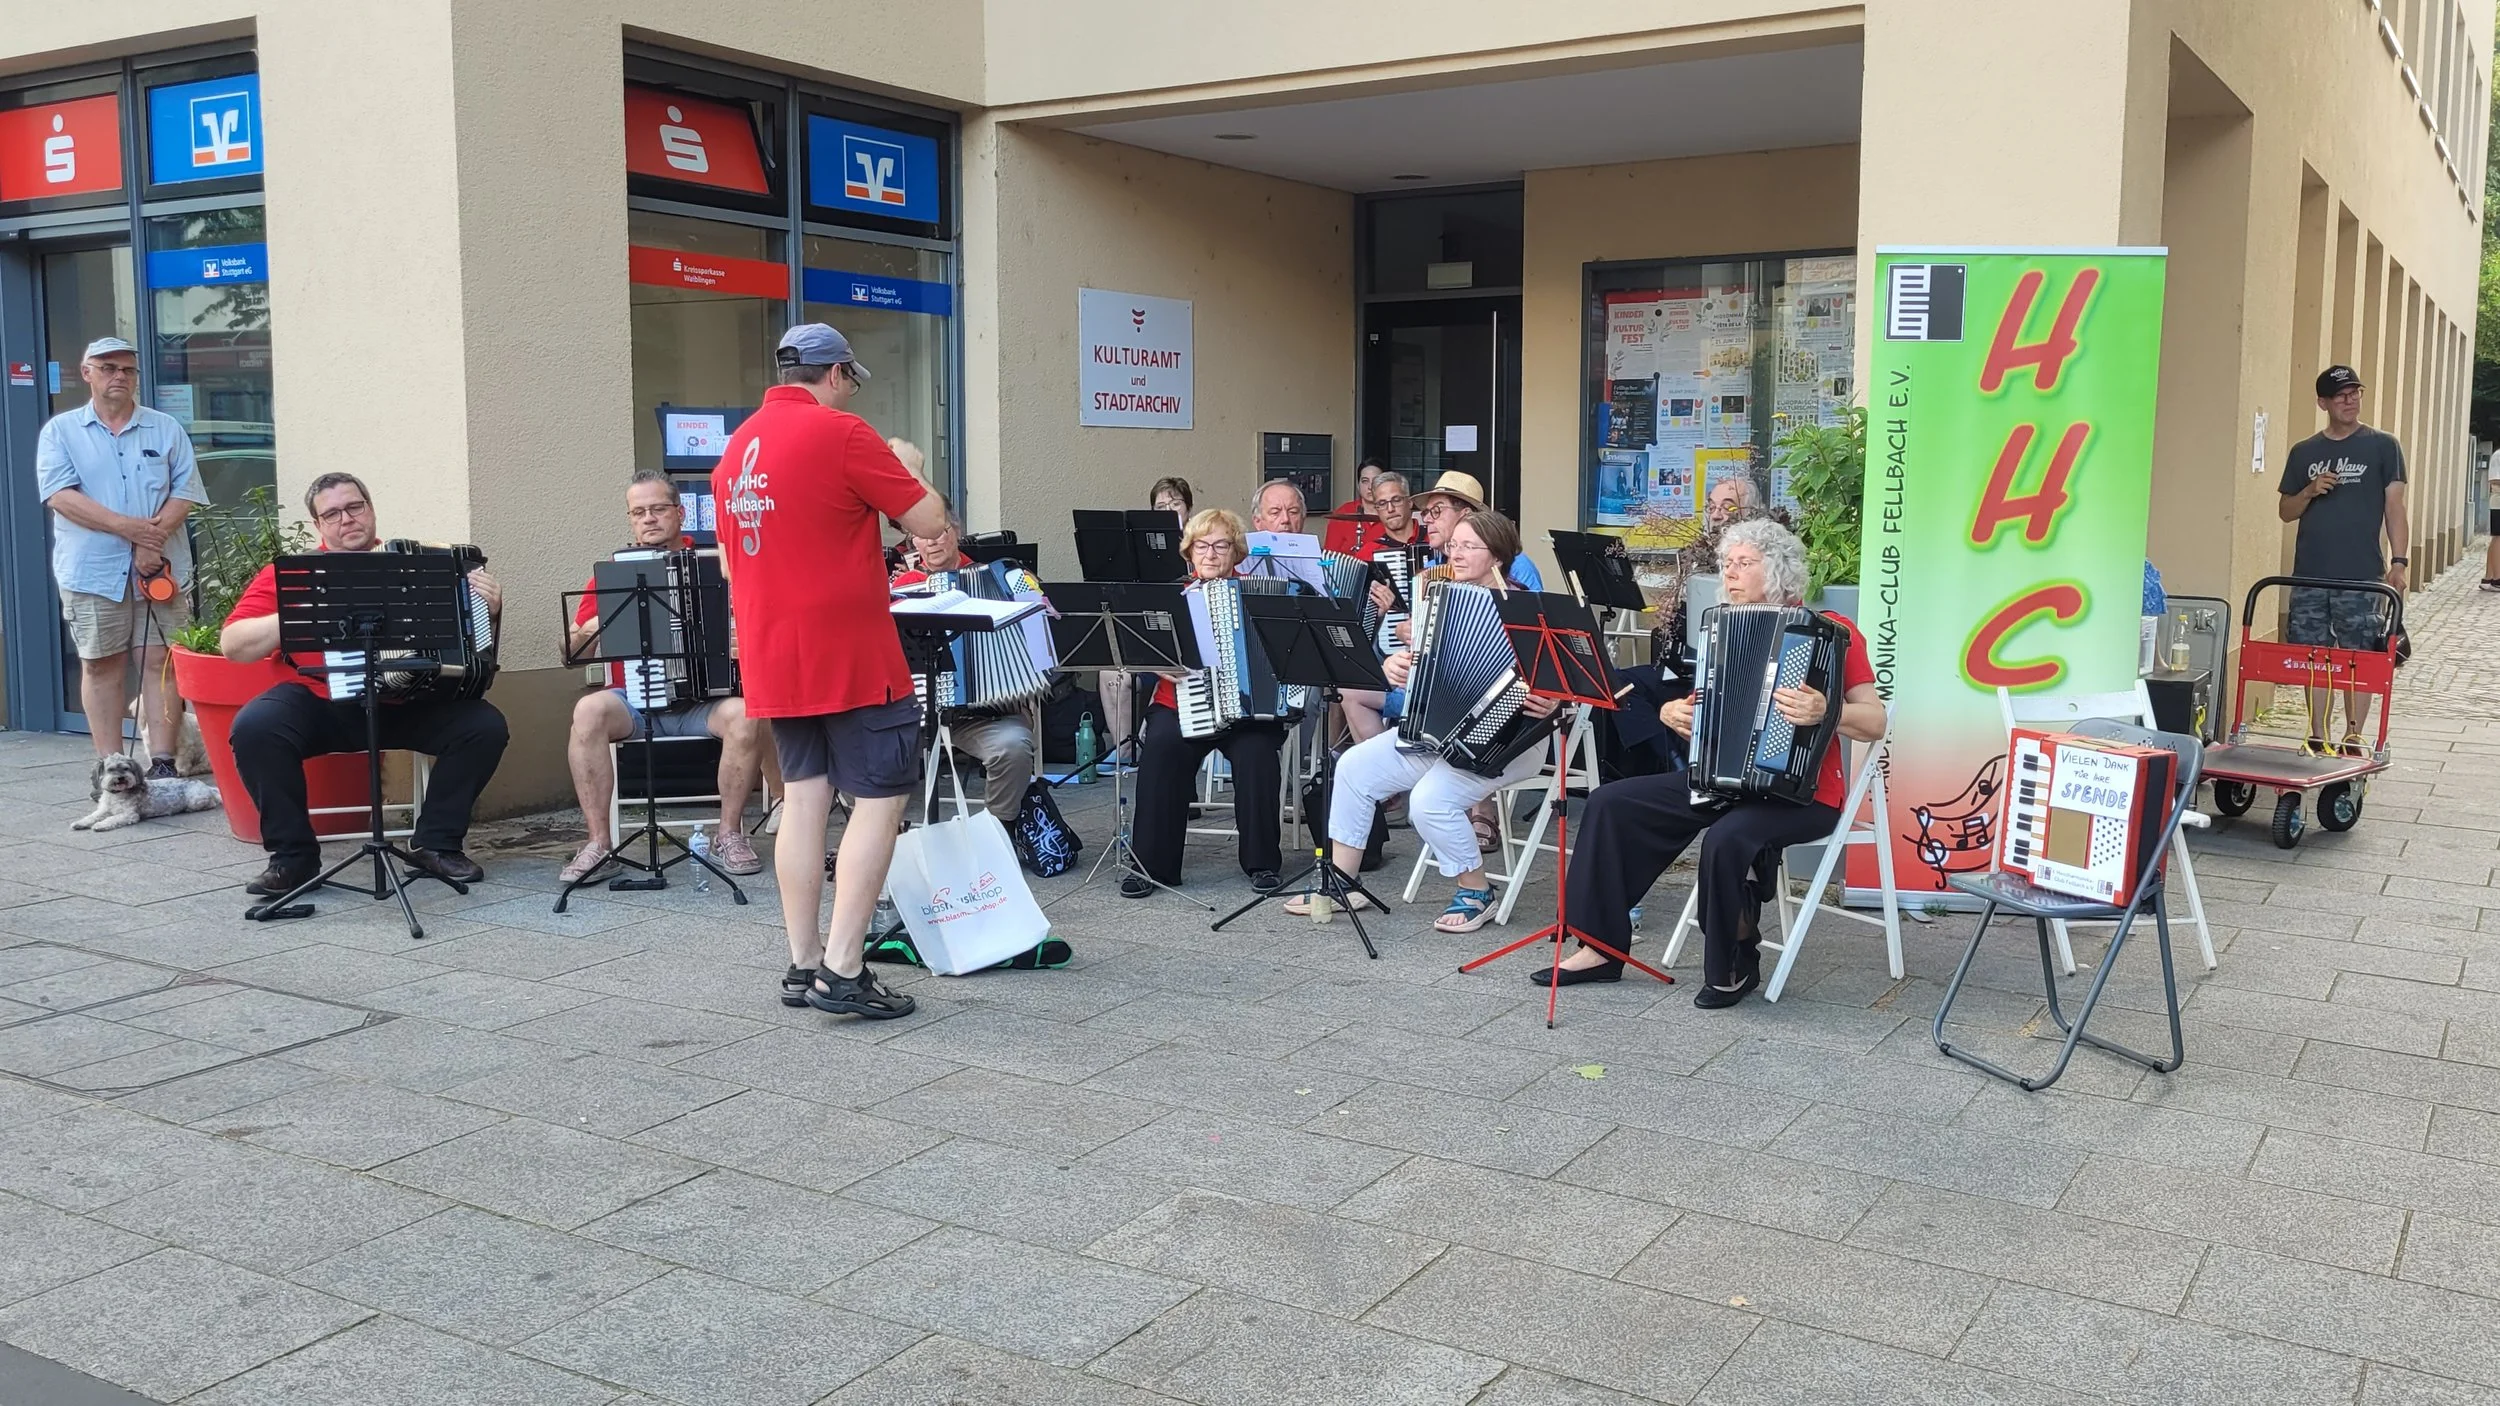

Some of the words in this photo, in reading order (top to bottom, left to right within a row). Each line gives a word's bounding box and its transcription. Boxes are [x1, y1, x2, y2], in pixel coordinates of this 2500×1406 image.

[221, 257, 247, 266] Volksbank
[222, 268, 245, 278] Stuttgart
[684, 264, 726, 277] Kreissparkasse
[683, 274, 716, 285] Waiblingen
[871, 286, 897, 296] Volksbank
[871, 295, 895, 305] Stuttgart
[1614, 310, 1644, 319] KINDER
[1613, 324, 1645, 333] KULTUR
[1621, 334, 1645, 344] FEST
[1094, 345, 1181, 369] KULTURAMT
[1131, 375, 1146, 386] und
[1889, 364, 1910, 408] E.V.
[1094, 392, 1181, 414] STADTARCHIV
[677, 421, 709, 429] KINDER
[2308, 459, 2331, 480] Old
[2335, 457, 2368, 474] Navy
[740, 473, 768, 490] HHC
[1883, 419, 1908, 533] FELLBACH
[725, 495, 775, 515] Fellbach
[2062, 749, 2098, 766] VIELEN
[2103, 756, 2130, 771] DANK
[2061, 782, 2128, 809] SPENDE
